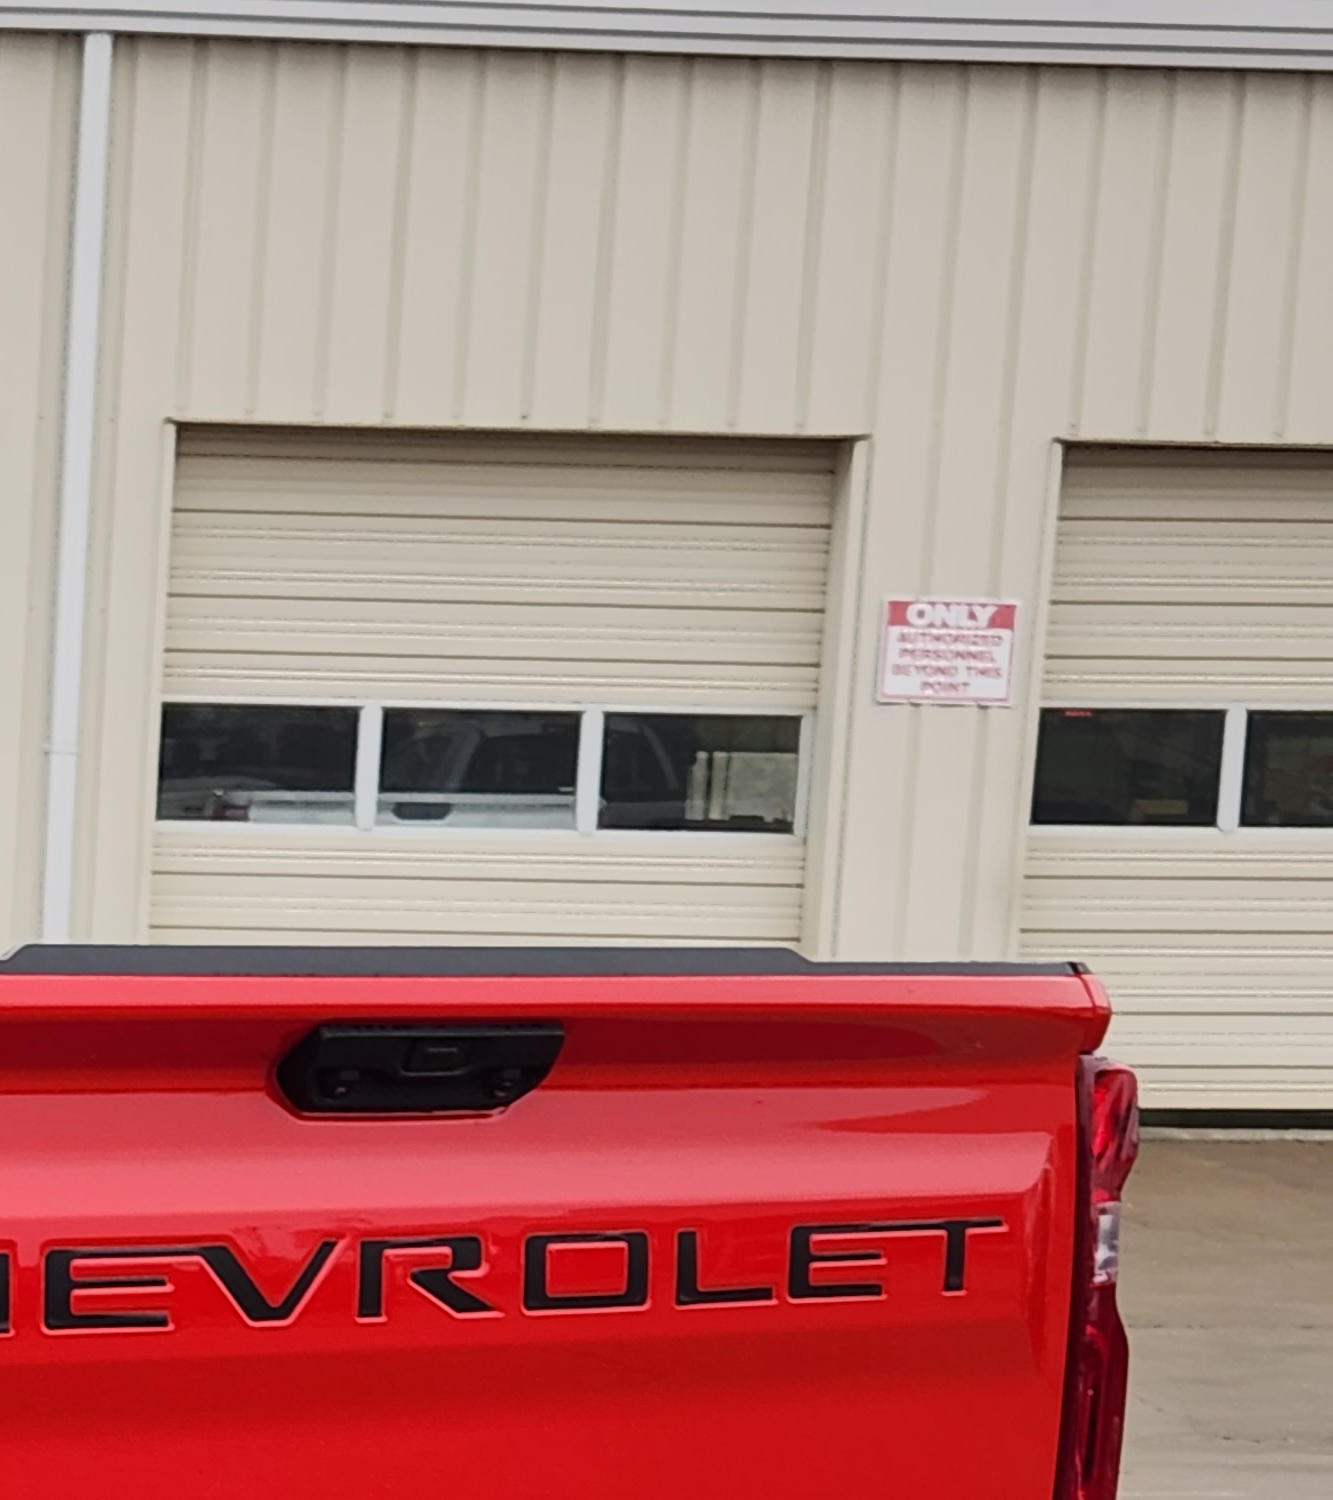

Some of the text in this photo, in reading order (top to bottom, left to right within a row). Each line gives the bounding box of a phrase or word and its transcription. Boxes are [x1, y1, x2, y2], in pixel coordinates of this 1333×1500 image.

[905, 602, 999, 628] ONLY
[896, 631, 1004, 647] AUTHORIZED
[898, 647, 997, 663] PERSONNEL
[891, 663, 1003, 680] BEYOND THIS
[920, 681, 971, 694] POINT
